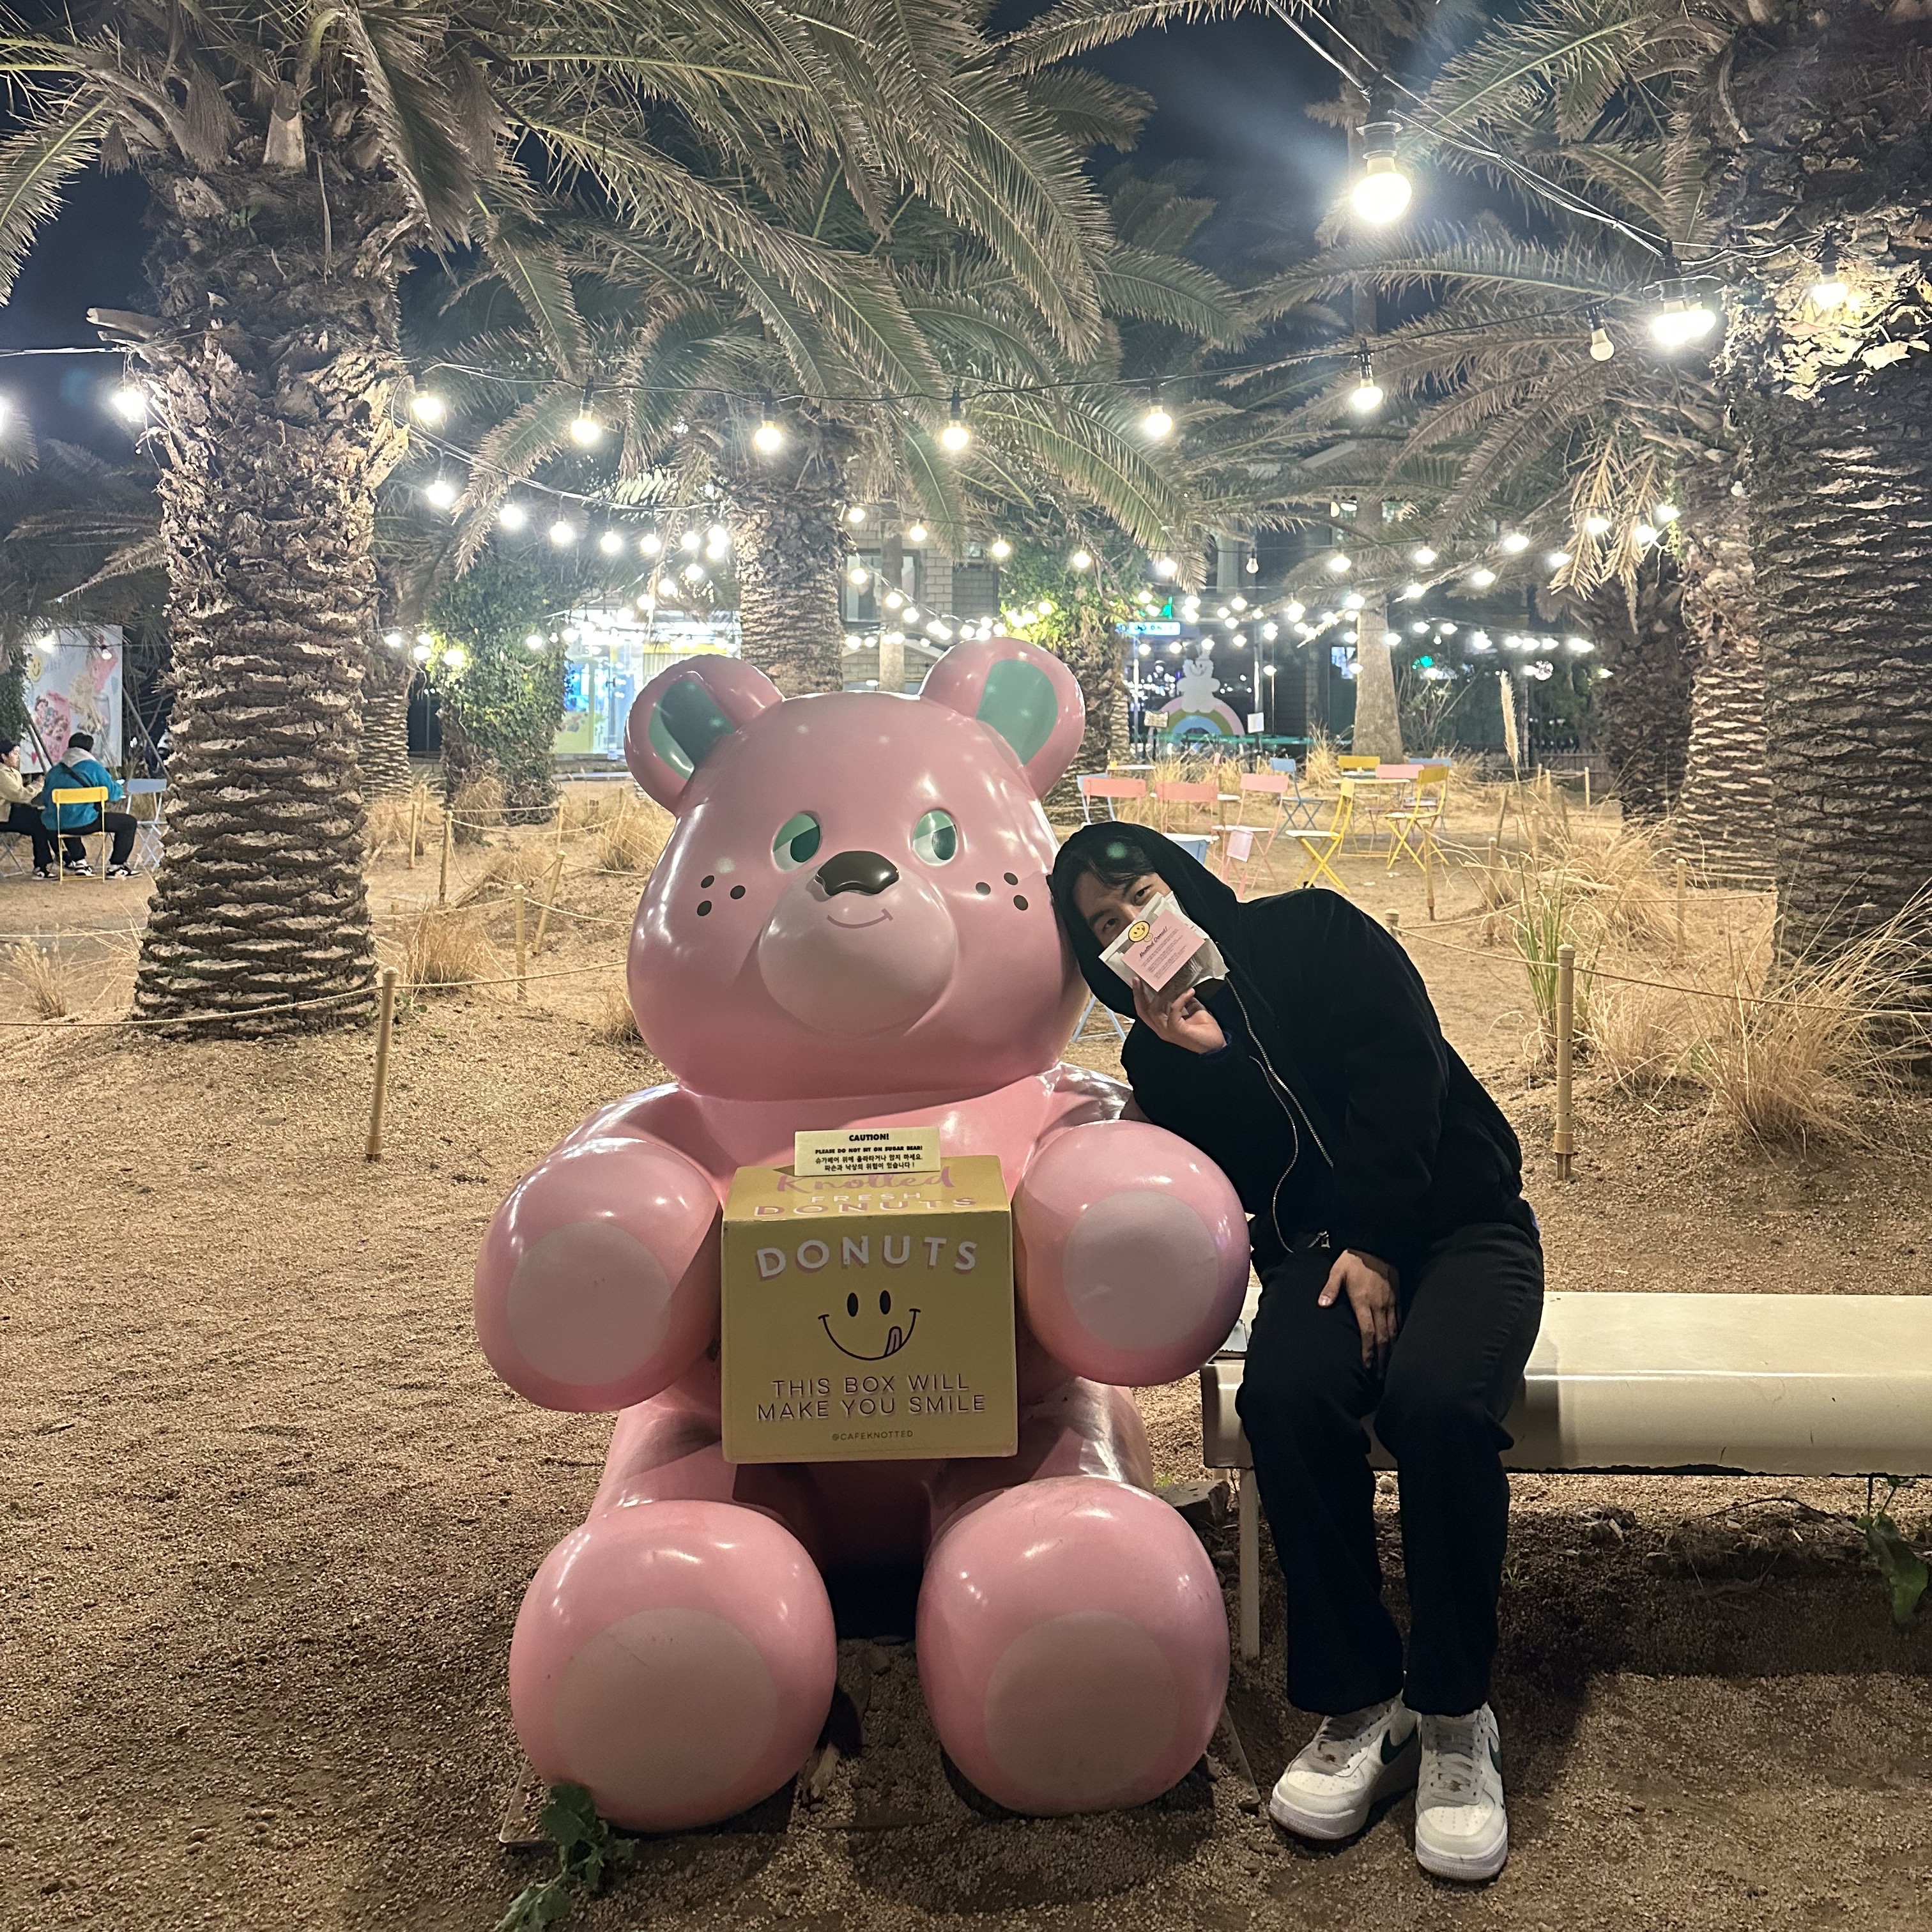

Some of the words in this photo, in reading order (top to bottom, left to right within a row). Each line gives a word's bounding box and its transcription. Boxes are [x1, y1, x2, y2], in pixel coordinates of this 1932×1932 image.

[849, 1133, 889, 1142] CAUTION!
[754, 1197, 977, 1216] DONUTS
[811, 1192, 921, 1203] FRESH
[756, 1235, 977, 1280] DONUTS
[771, 1378, 831, 1398] THIS
[844, 1376, 895, 1395] BOX
[908, 1374, 970, 1392] WILL
[757, 1400, 829, 1422] MAKE
[841, 1398, 895, 1416] YOU
[909, 1394, 985, 1414] SMILE
[832, 1430, 914, 1441] @CAFEKNOTTED
